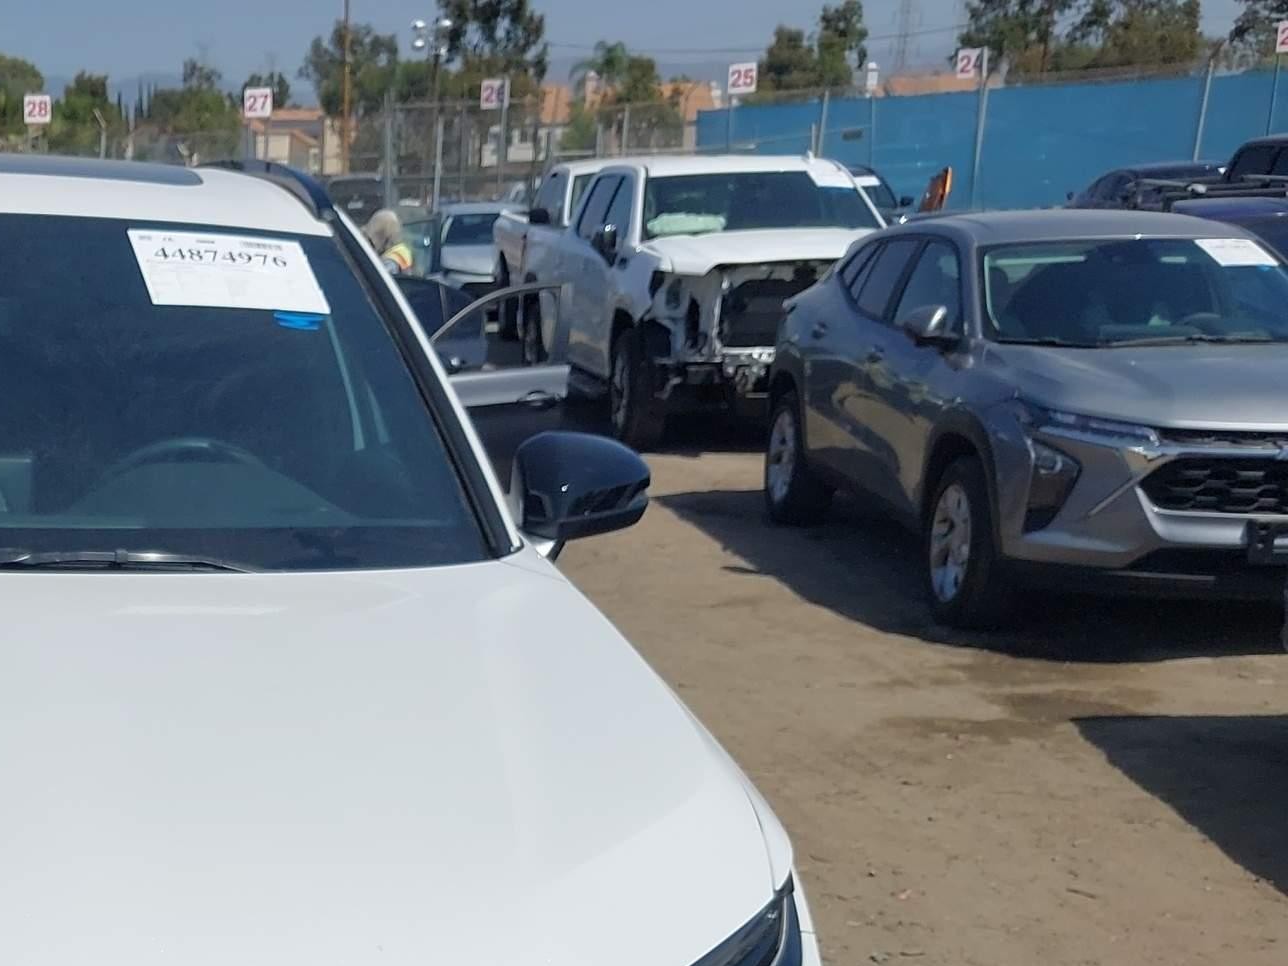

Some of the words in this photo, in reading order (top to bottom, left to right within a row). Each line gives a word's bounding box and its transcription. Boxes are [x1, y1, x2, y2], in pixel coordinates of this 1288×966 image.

[731, 68, 754, 89] 25
[27, 102, 48, 118] 28
[246, 95, 269, 113] 27
[154, 247, 288, 268] 44874976
